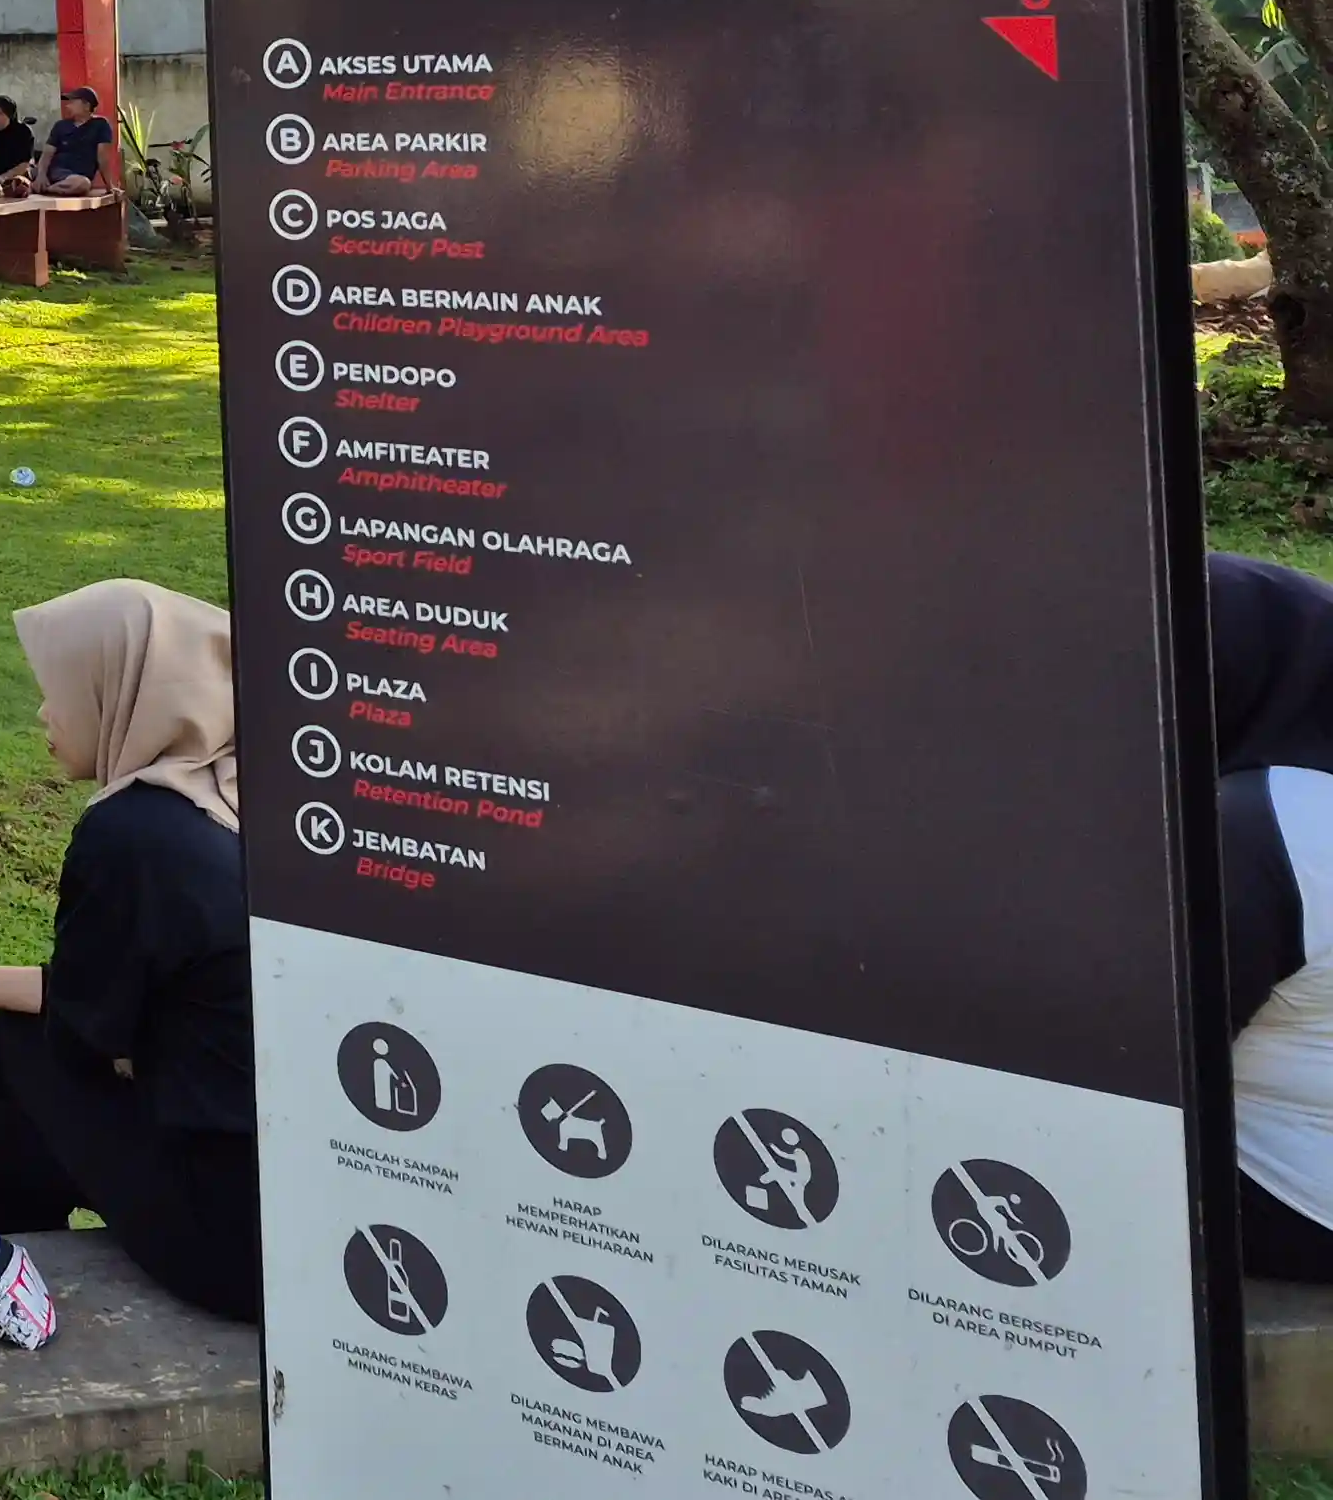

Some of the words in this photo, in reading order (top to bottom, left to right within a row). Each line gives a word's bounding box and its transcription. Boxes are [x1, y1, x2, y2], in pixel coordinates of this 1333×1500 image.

[319, 56, 396, 75] AKSES
[403, 53, 492, 75] UTAMA
[324, 84, 378, 103] Main
[385, 83, 496, 100] Entrance
[322, 133, 388, 152] AREA
[395, 132, 487, 152] PARKIR
[325, 160, 415, 182] Parking
[421, 161, 477, 179] Area
[327, 210, 375, 229] POS
[381, 211, 447, 231] JAGA
[329, 236, 424, 261] Security
[431, 239, 485, 258] Post
[329, 286, 395, 307] AREA
[402, 288, 518, 312] BERMAIN
[525, 294, 601, 316] ANAK
[334, 312, 431, 334] Children
[438, 318, 582, 343] Playground
[587, 326, 649, 347] Area
[334, 363, 456, 387] PENDOPO
[335, 389, 420, 412] Shelter
[336, 440, 490, 469] AMFITEATER
[338, 468, 507, 499] Amphitheater
[340, 516, 475, 548] LAPANGAN
[482, 531, 632, 565] OLAHRAGA
[341, 543, 407, 568] Sport
[413, 551, 472, 575] Field
[343, 594, 409, 620] AREA
[416, 603, 509, 632] DUDUK
[346, 621, 436, 654] Seating
[441, 634, 497, 659] Area
[347, 673, 427, 702] PLAZA
[349, 701, 412, 727] Plaza
[350, 751, 437, 783] KOLAM
[445, 766, 550, 801] RETENSI
[354, 779, 469, 815] Retention
[477, 799, 544, 828] Pond
[353, 829, 486, 871] JEMBATAN
[357, 856, 436, 890] Bridge
[329, 1138, 400, 1166] BUANGLAH
[404, 1157, 459, 1182] SAMPAH
[337, 1156, 372, 1174] PADA
[375, 1164, 453, 1194] TEMPATNYA
[517, 1203, 640, 1244] MEMPERHATIKAN
[553, 1197, 602, 1217] HARAP
[506, 1216, 559, 1238] HEWAN
[563, 1230, 653, 1263] PELIHARAAN
[701, 1234, 779, 1265] DILARANG
[784, 1254, 861, 1286] MERUSAK
[714, 1255, 788, 1284] FASILITAS
[791, 1274, 847, 1299] TAMAN
[908, 1288, 993, 1322] DILARANG
[999, 1312, 1102, 1349] BERSEPEDA
[932, 1312, 949, 1326] DI
[954, 1318, 1000, 1341] AREA
[1005, 1331, 1076, 1359] RUMPUT
[333, 1338, 397, 1368] DILARANG
[401, 1360, 472, 1391] MEMBAWA
[348, 1357, 410, 1386] MINUMAN
[415, 1378, 458, 1401] KERAS
[511, 1393, 581, 1425] DILARANG
[586, 1417, 665, 1451] MEMBAWA
[521, 1412, 593, 1444] MAKANAN
[597, 1434, 611, 1449] DI
[615, 1440, 654, 1463] AREA
[533, 1431, 598, 1461] BERMAIN
[603, 1453, 642, 1475] ANAK
[703, 1469, 737, 1488] KAKI
[742, 1482, 757, 1495] DI
[705, 1453, 757, 1477] HARAP
[762, 1471, 833, 1500] MELEPAS
